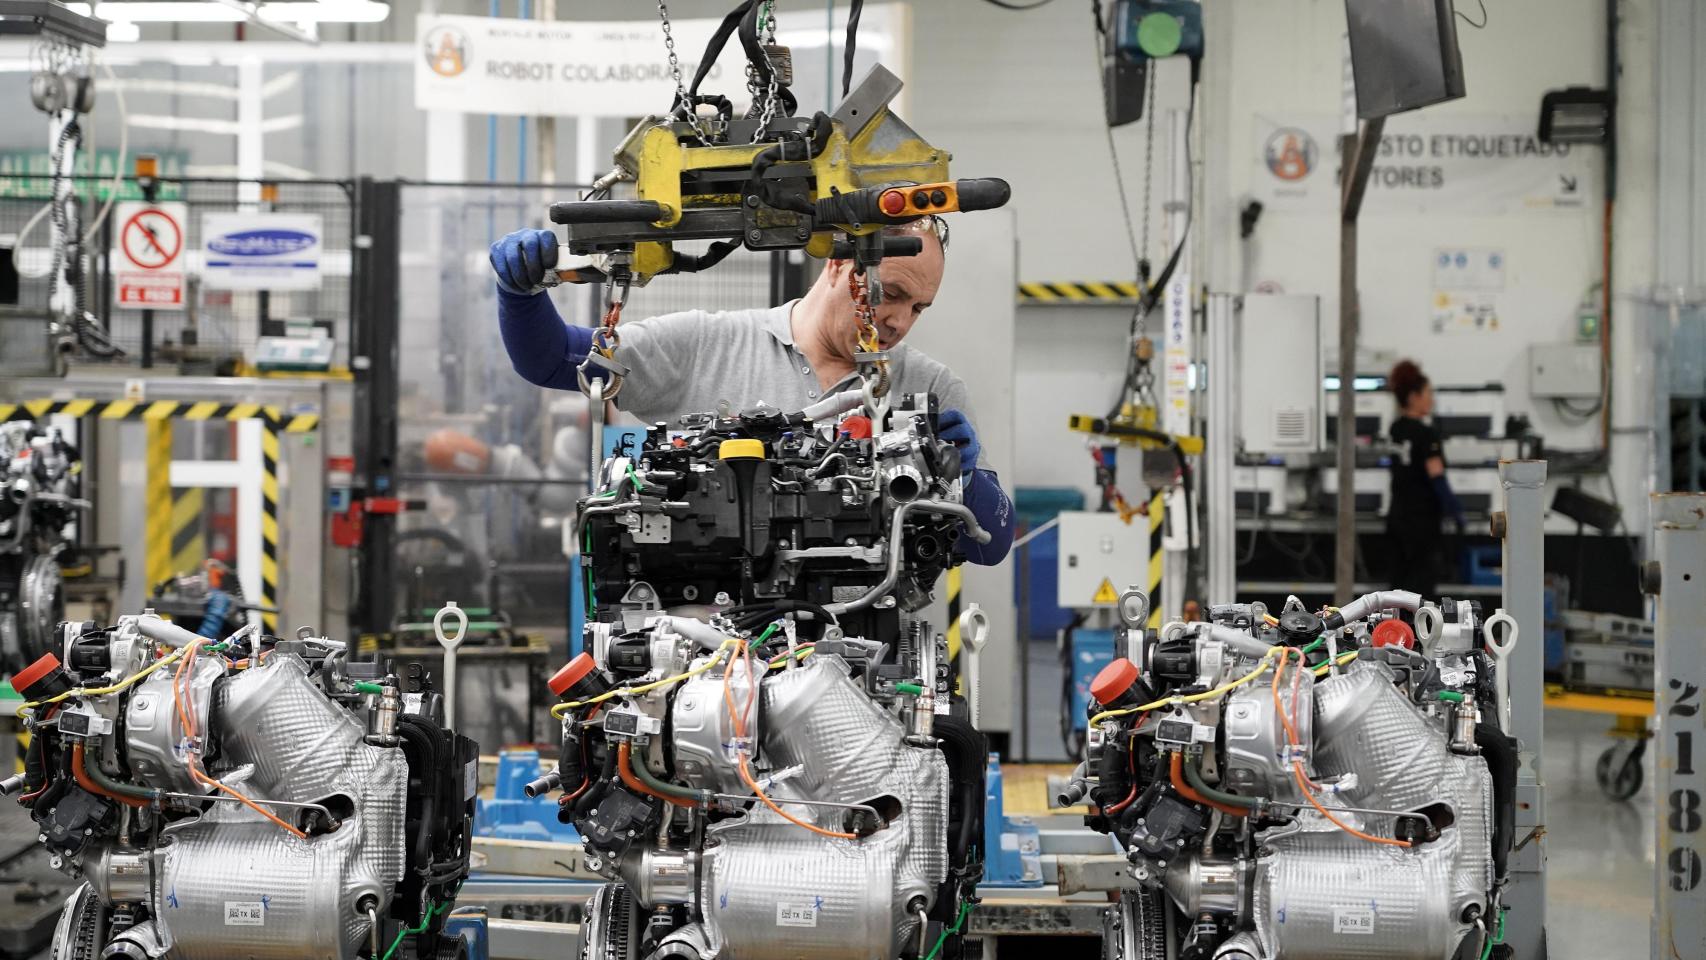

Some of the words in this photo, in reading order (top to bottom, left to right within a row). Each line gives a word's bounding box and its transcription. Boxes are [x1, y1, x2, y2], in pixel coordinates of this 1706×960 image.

[487, 61, 554, 80] ROBOT
[562, 61, 723, 82] COLABORATIO
[1336, 166, 1444, 188] TORES
[1668, 678, 1702, 892] 2189
